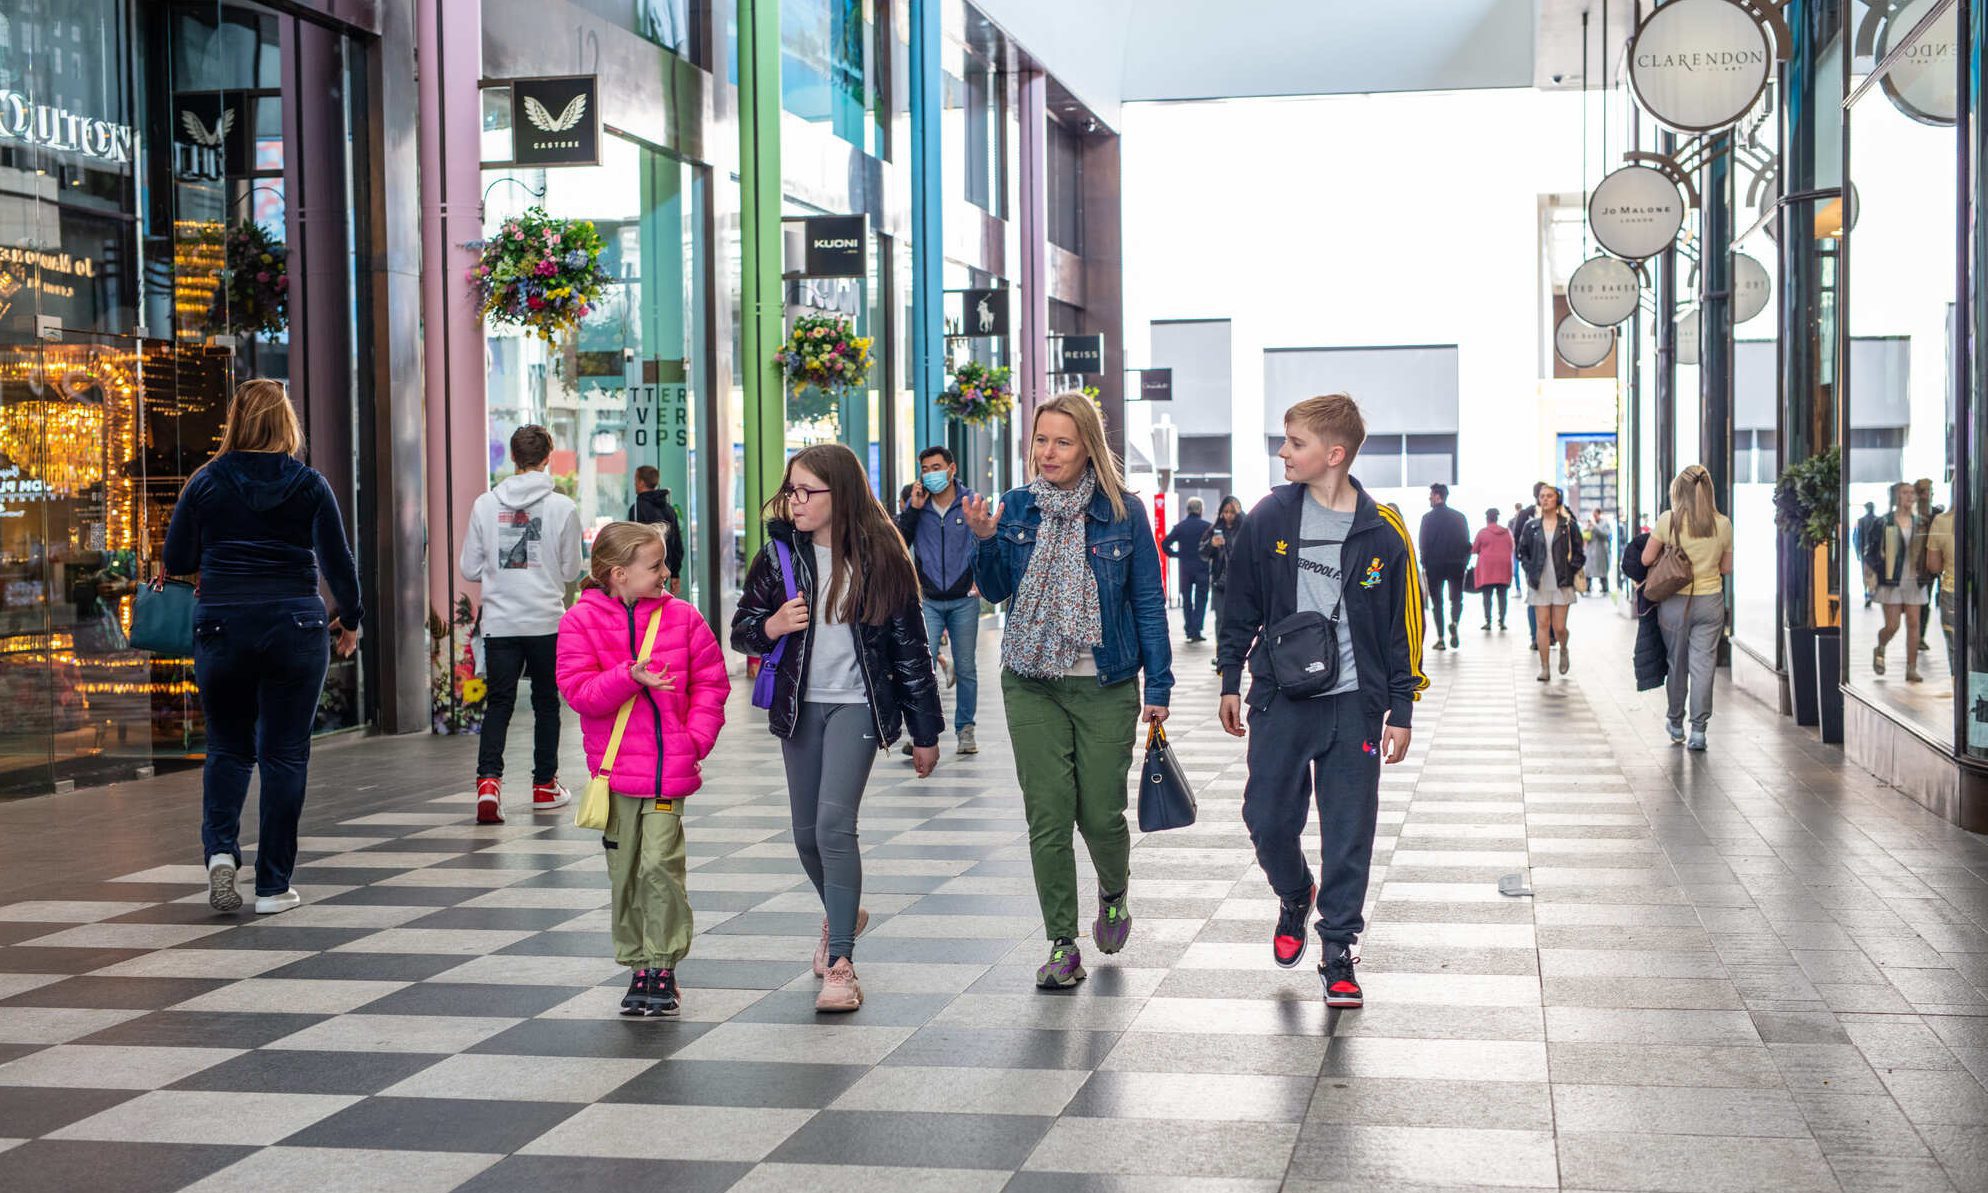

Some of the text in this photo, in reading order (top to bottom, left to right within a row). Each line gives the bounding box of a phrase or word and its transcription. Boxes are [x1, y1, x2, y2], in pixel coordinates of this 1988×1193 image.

[1638, 51, 1762, 71] CLARENDON
[533, 140, 580, 149] CASTORE
[1620, 206, 1671, 214] MALONE
[813, 238, 858, 249] KUONI
[1064, 350, 1099, 359] REISS
[1297, 557, 1335, 579] ERPOOL
